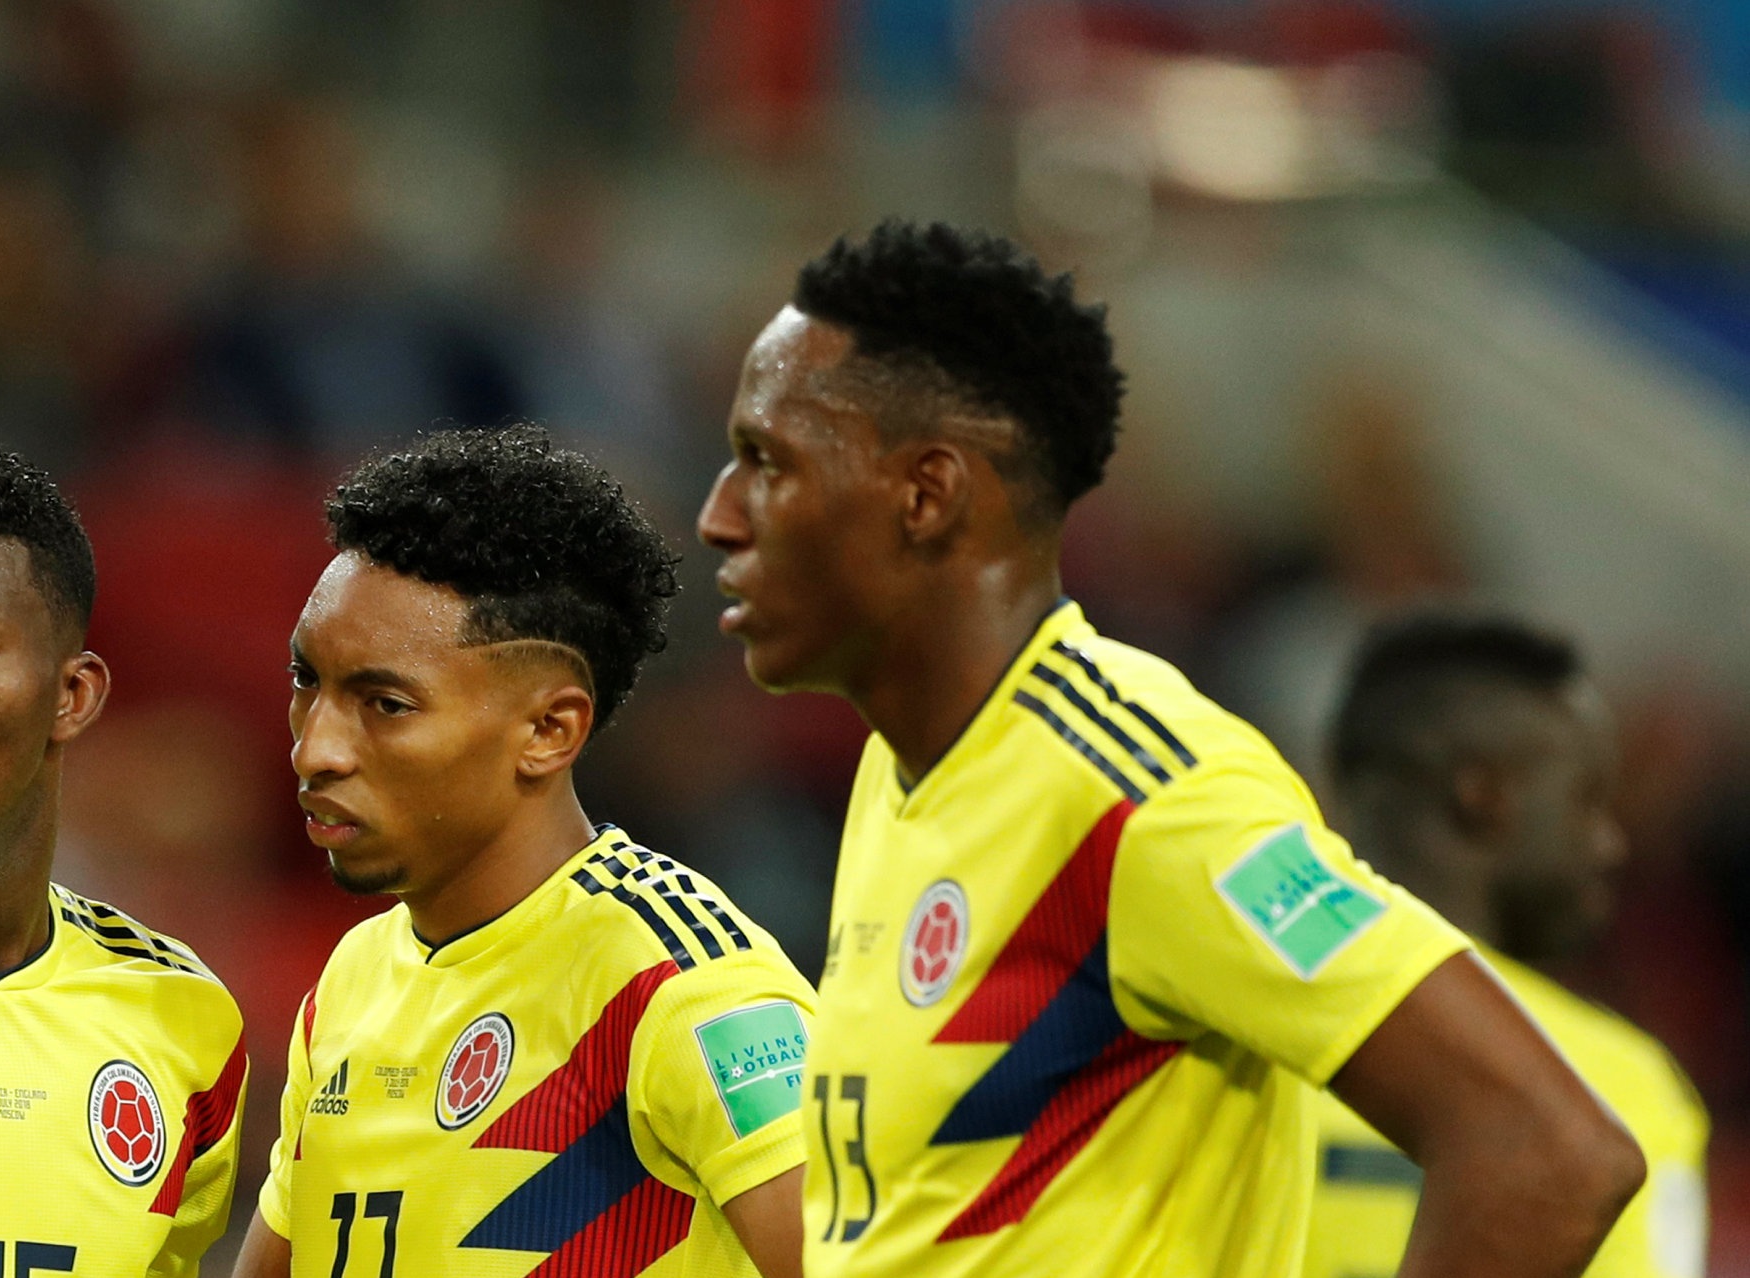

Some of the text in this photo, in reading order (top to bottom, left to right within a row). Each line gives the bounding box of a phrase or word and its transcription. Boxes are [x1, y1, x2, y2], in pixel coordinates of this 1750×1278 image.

[715, 1034, 804, 1071] LIVING
[785, 1073, 803, 1088] FI
[814, 1075, 877, 1242] 13
